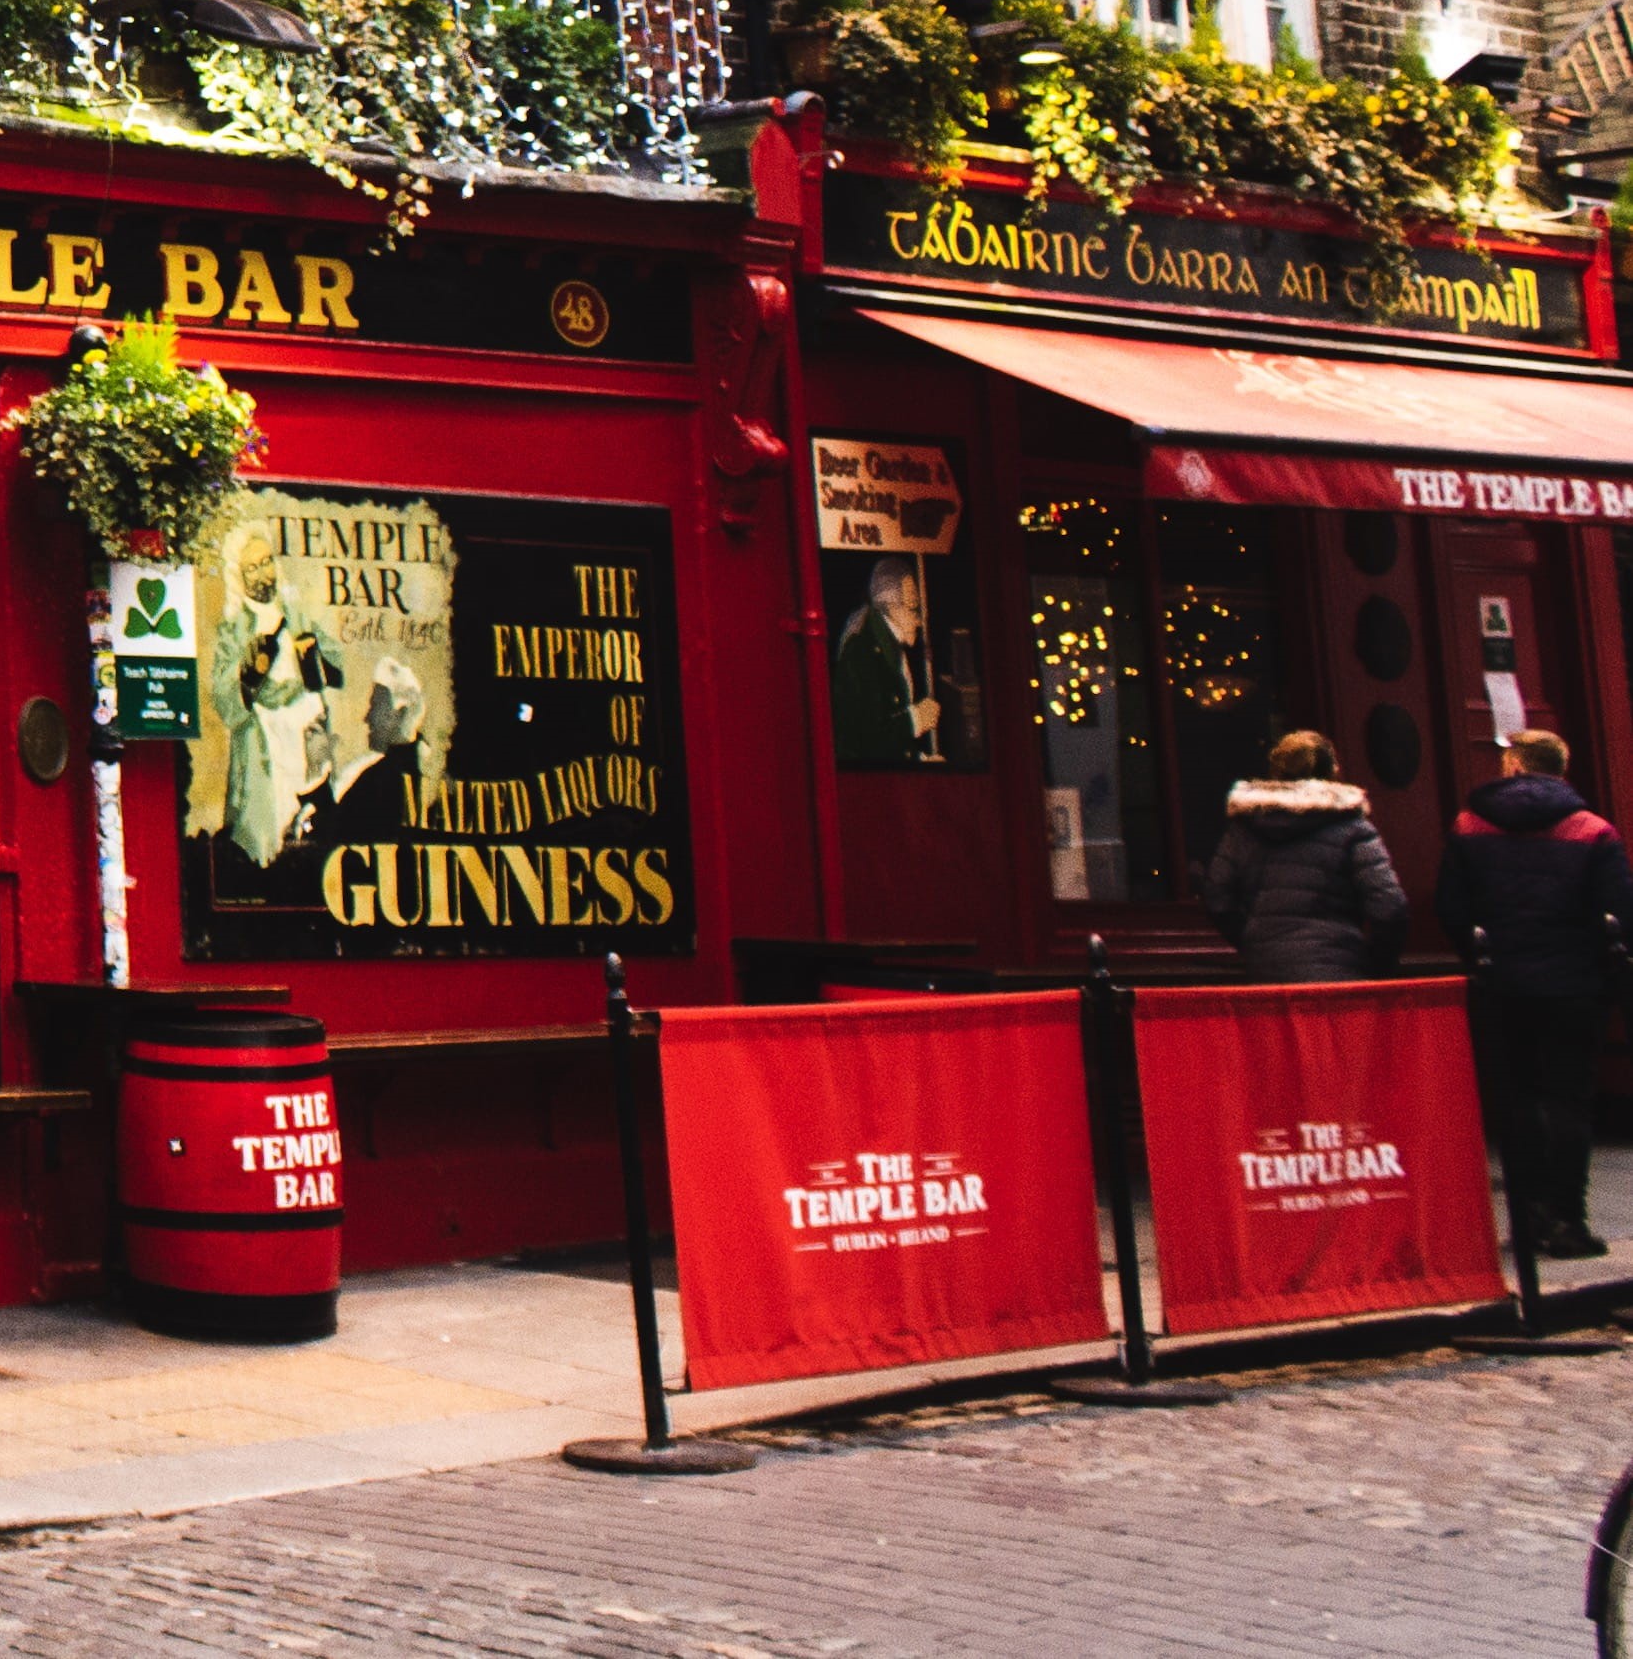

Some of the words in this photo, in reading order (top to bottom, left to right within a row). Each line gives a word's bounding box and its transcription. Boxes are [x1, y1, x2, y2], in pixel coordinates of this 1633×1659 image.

[158, 243, 360, 331] BAR
[558, 290, 596, 334] 48
[819, 447, 860, 478] Beer
[1393, 468, 1464, 508] THE
[1467, 472, 1595, 516] TEMPLE
[1598, 480, 1633, 518] BA
[268, 516, 442, 564] TEMPLE
[324, 565, 409, 615] BAR
[575, 565, 640, 619] THE
[492, 624, 644, 683] EMPEROR
[610, 695, 645, 747] OF
[400, 770, 532, 836] MALTED
[537, 753, 662, 826] LIQUORS
[322, 844, 675, 927] GUINNESS
[265, 1092, 330, 1129] THE
[1299, 1122, 1342, 1148] THE
[275, 1172, 336, 1208] BAR
[857, 1153, 913, 1183] THE
[1240, 1148, 1343, 1190] TEMPLE
[1345, 1143, 1406, 1180] BAR
[784, 1184, 917, 1229] TEMPLE
[922, 1174, 988, 1216] BAR
